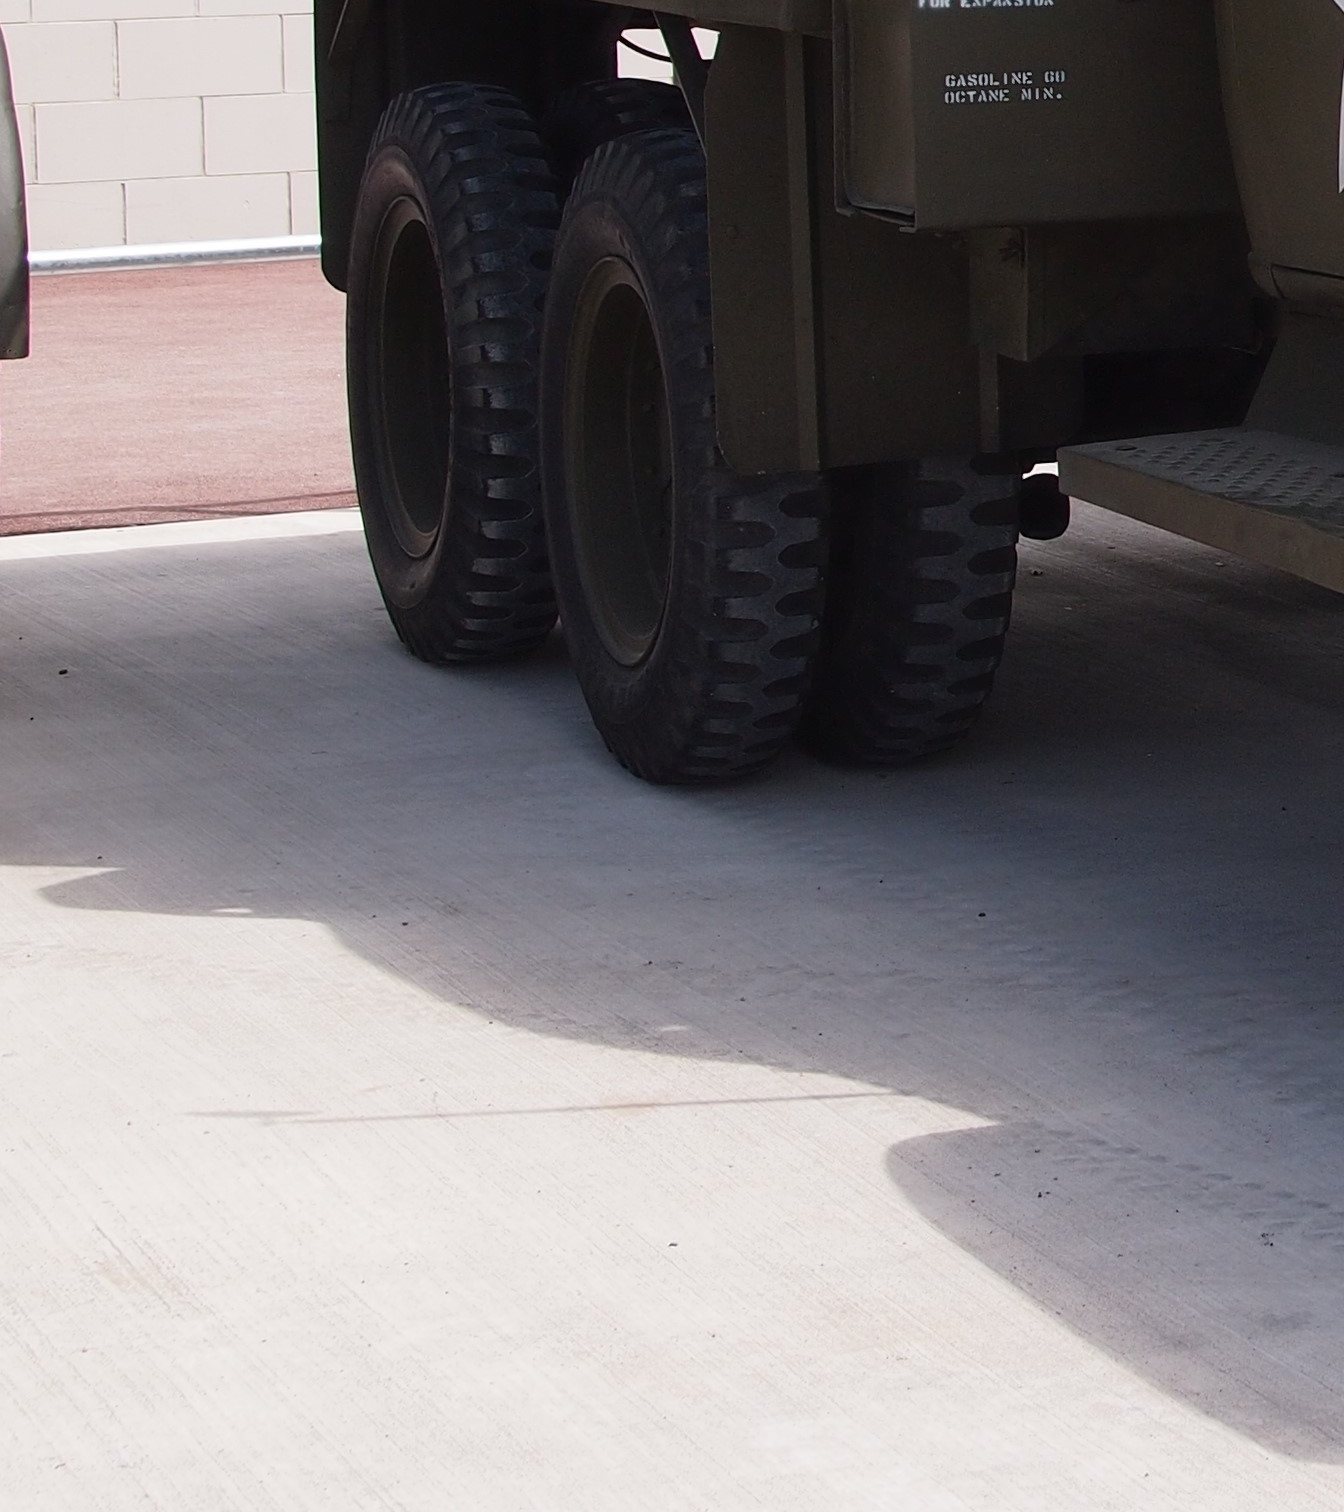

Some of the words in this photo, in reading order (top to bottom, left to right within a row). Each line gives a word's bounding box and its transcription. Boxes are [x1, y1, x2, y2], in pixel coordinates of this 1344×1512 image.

[945, 72, 1033, 88] GASOLINE
[944, 89, 1010, 104] OCTANE
[1021, 87, 1063, 102] MIN.
